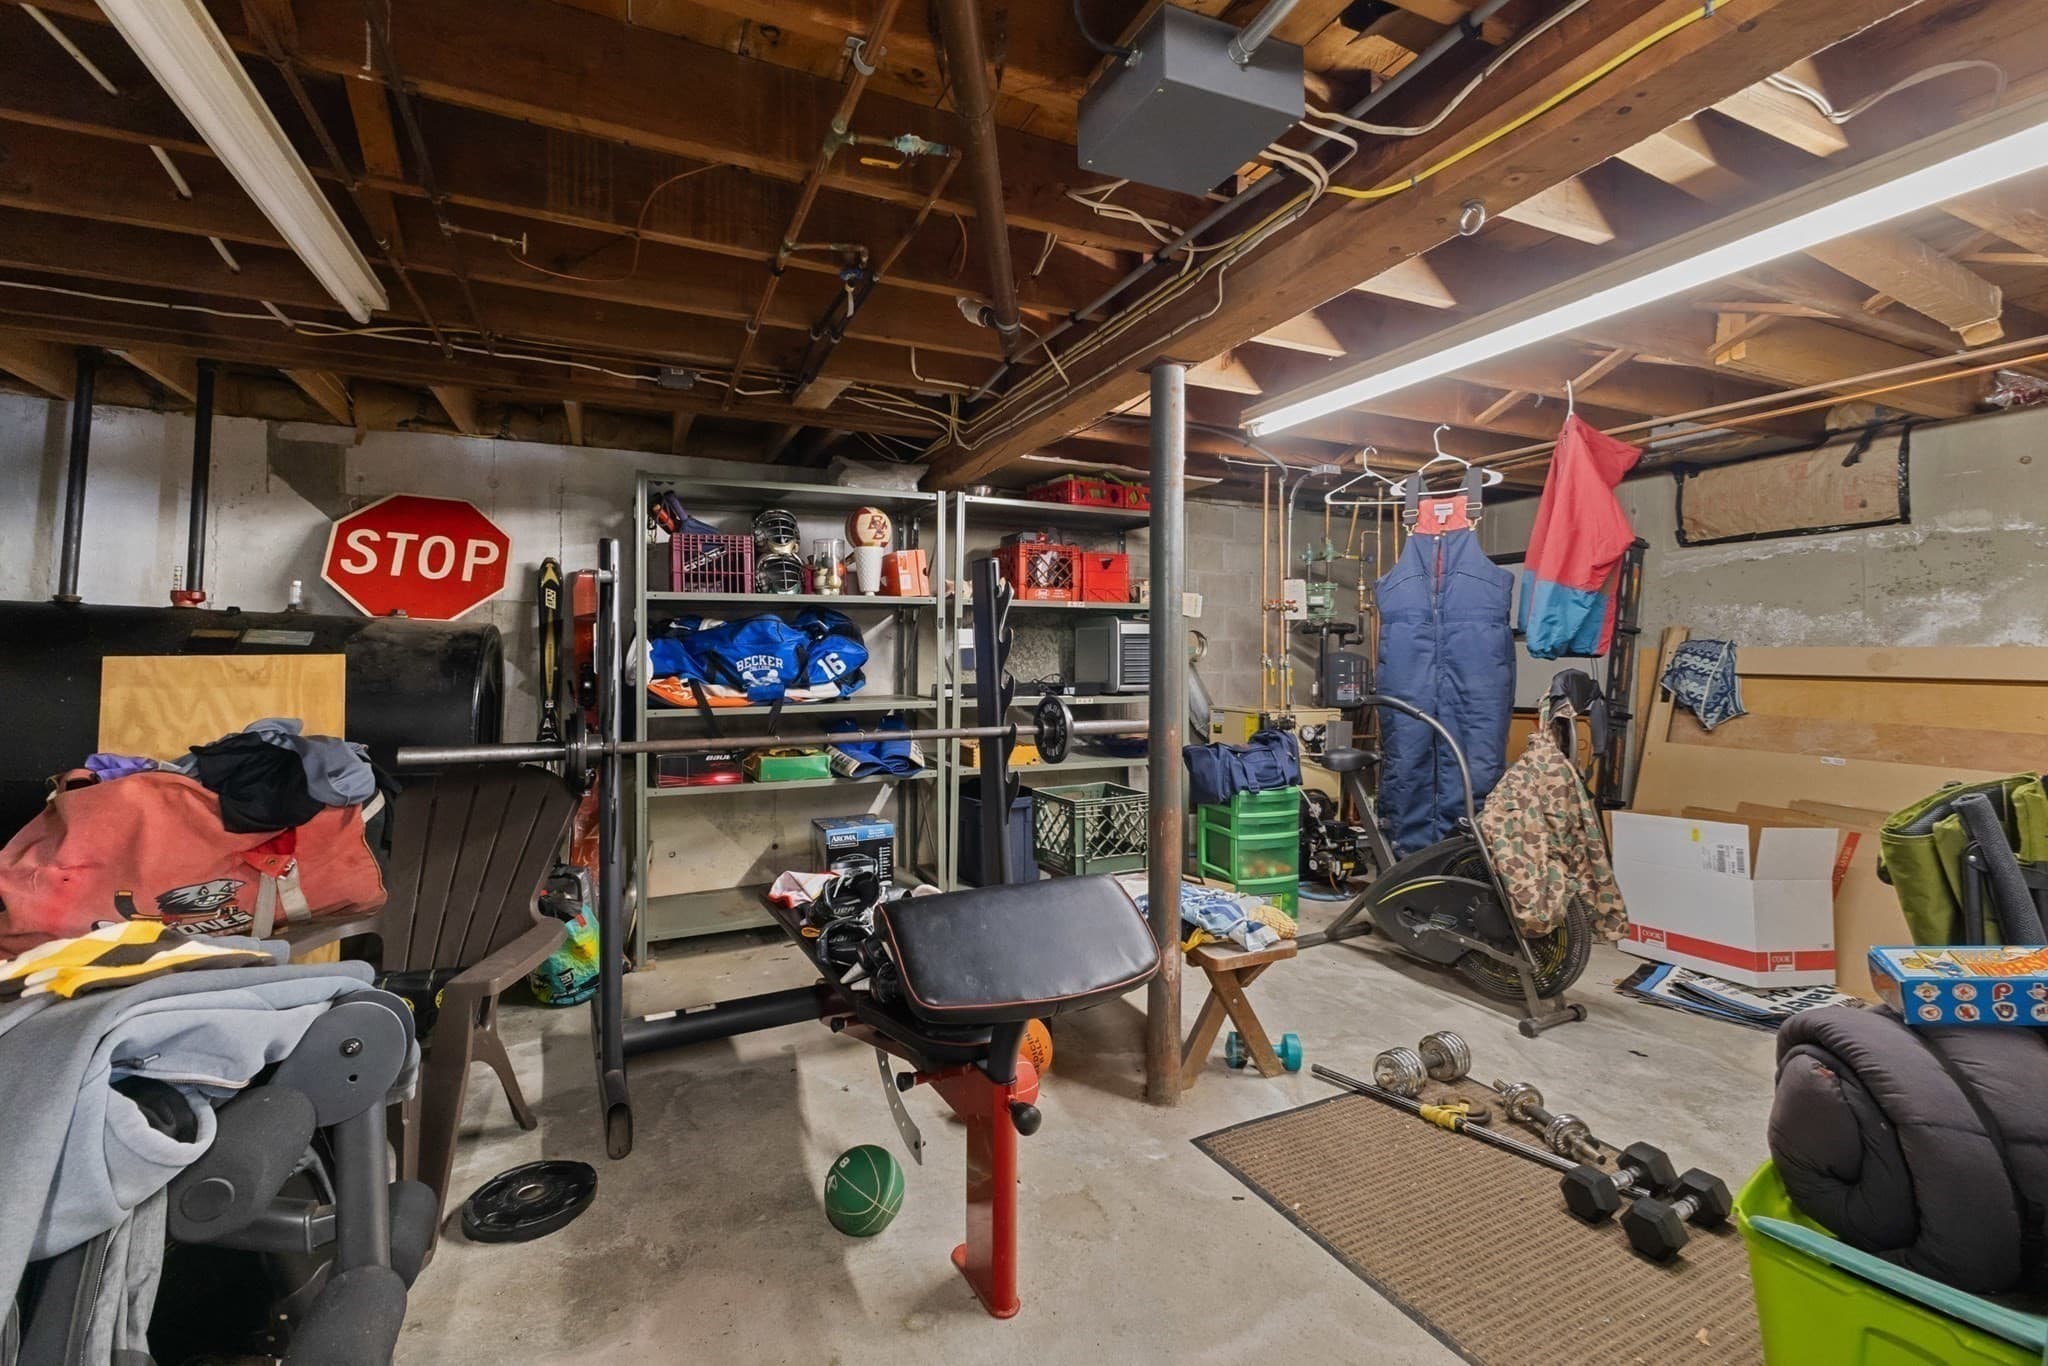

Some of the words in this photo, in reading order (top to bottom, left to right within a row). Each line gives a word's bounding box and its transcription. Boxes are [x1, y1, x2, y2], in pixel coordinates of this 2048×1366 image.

[340, 528, 500, 582] STOP
[736, 654, 784, 672] BECKER
[816, 652, 847, 681] 16
[831, 834, 857, 843] AROMA
[176, 911, 254, 936] ONES
[1023, 1031, 1040, 1076] MEDICIN
[1034, 1036, 1045, 1064] BALL
